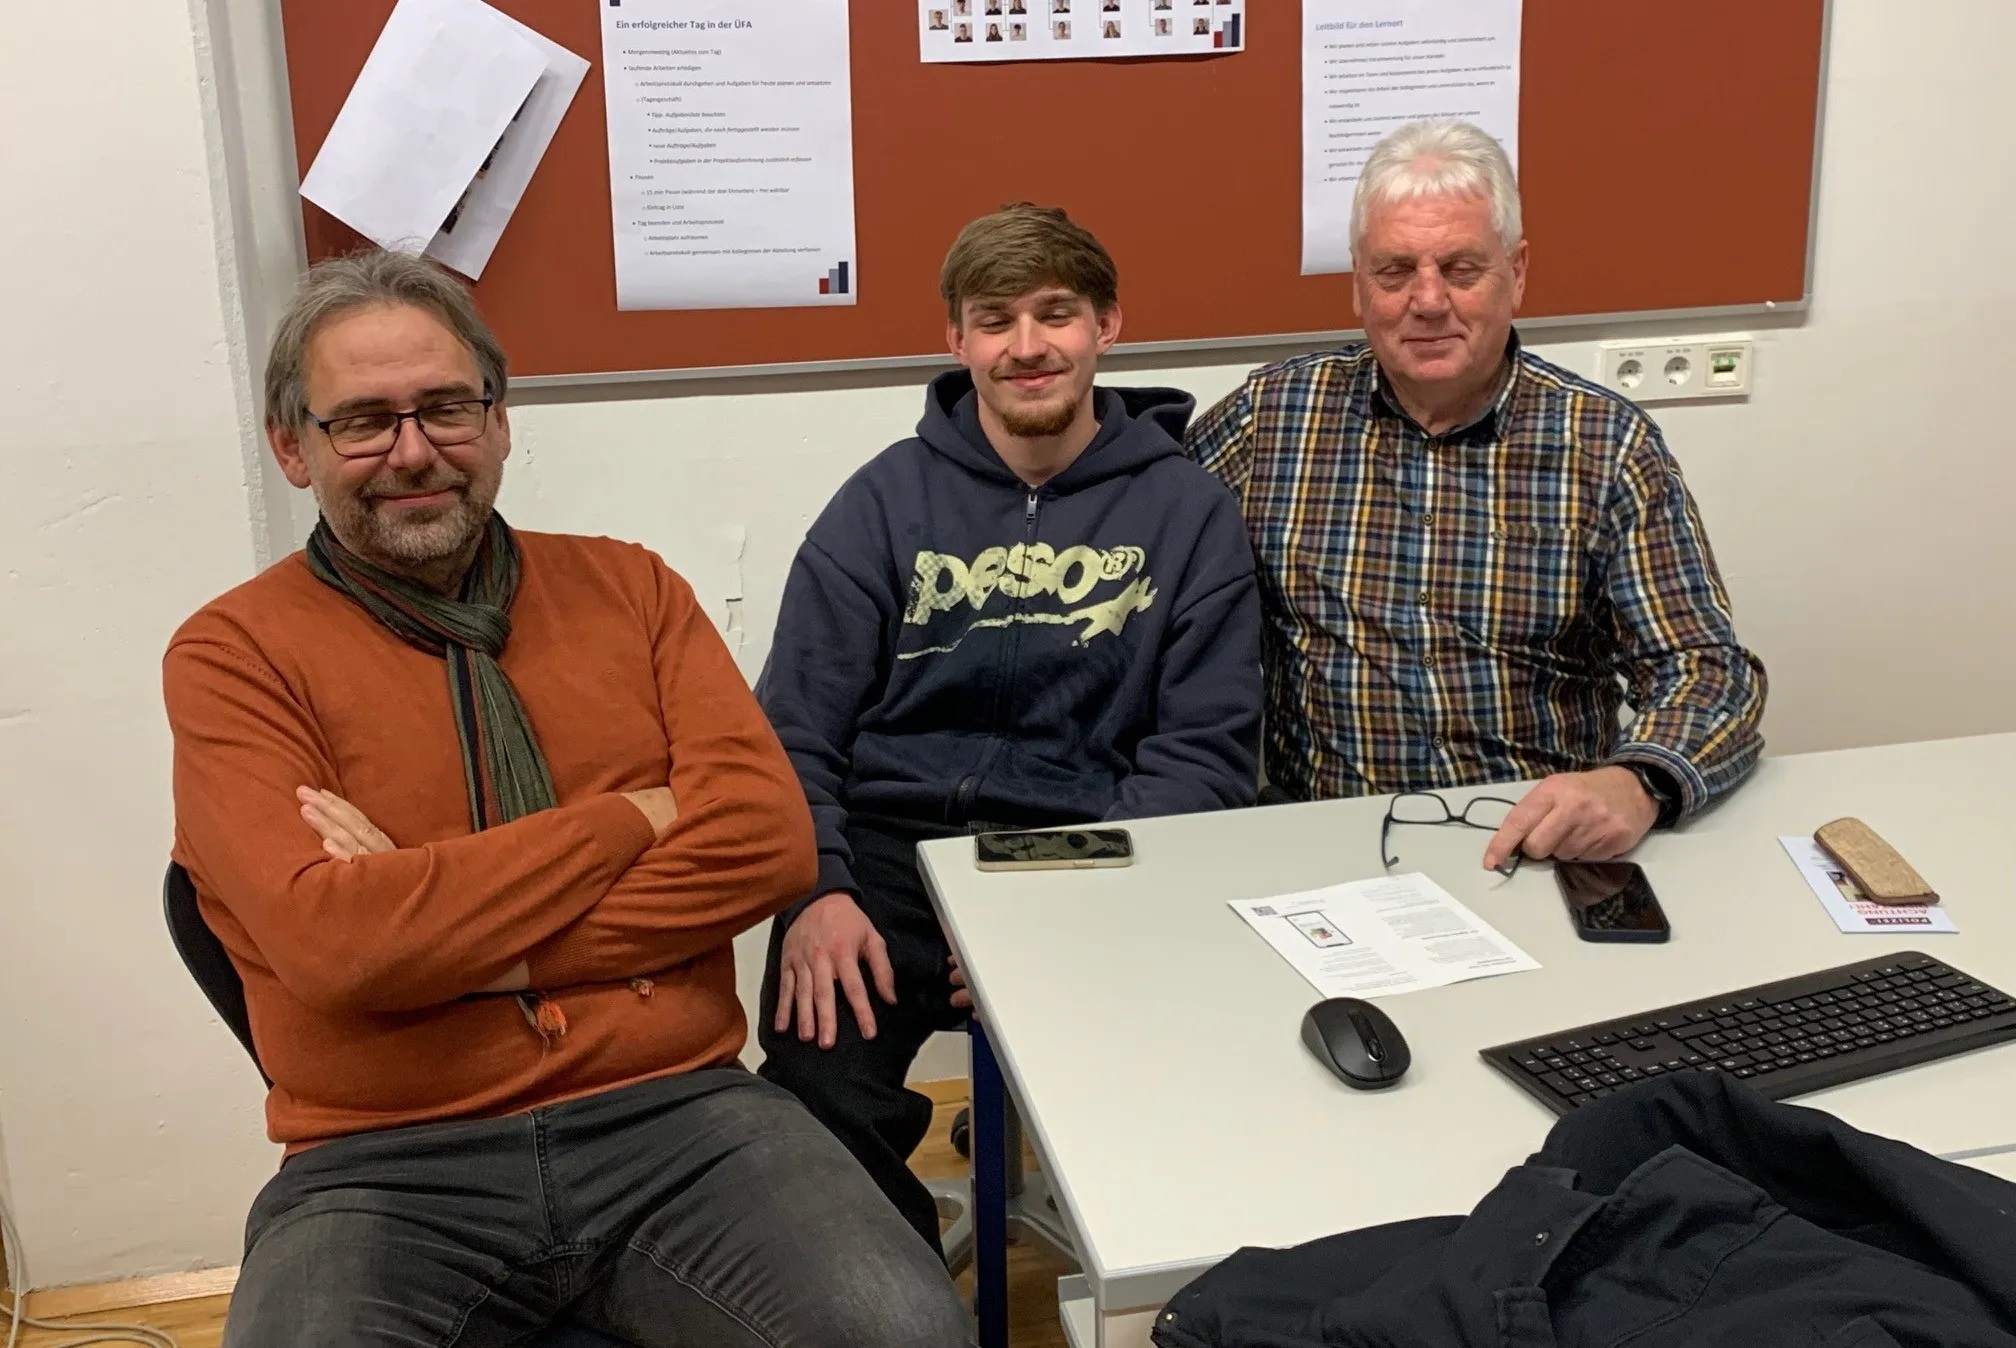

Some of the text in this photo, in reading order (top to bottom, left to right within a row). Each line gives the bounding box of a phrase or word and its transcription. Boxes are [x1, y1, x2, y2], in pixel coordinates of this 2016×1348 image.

[616, 20, 630, 28] Ein
[632, 20, 688, 30] erfolgreicher
[690, 20, 705, 30] Tag
[718, 20, 732, 28] der
[734, 19, 752, 28] ÜFA
[1315, 22, 1344, 31] Leitbild
